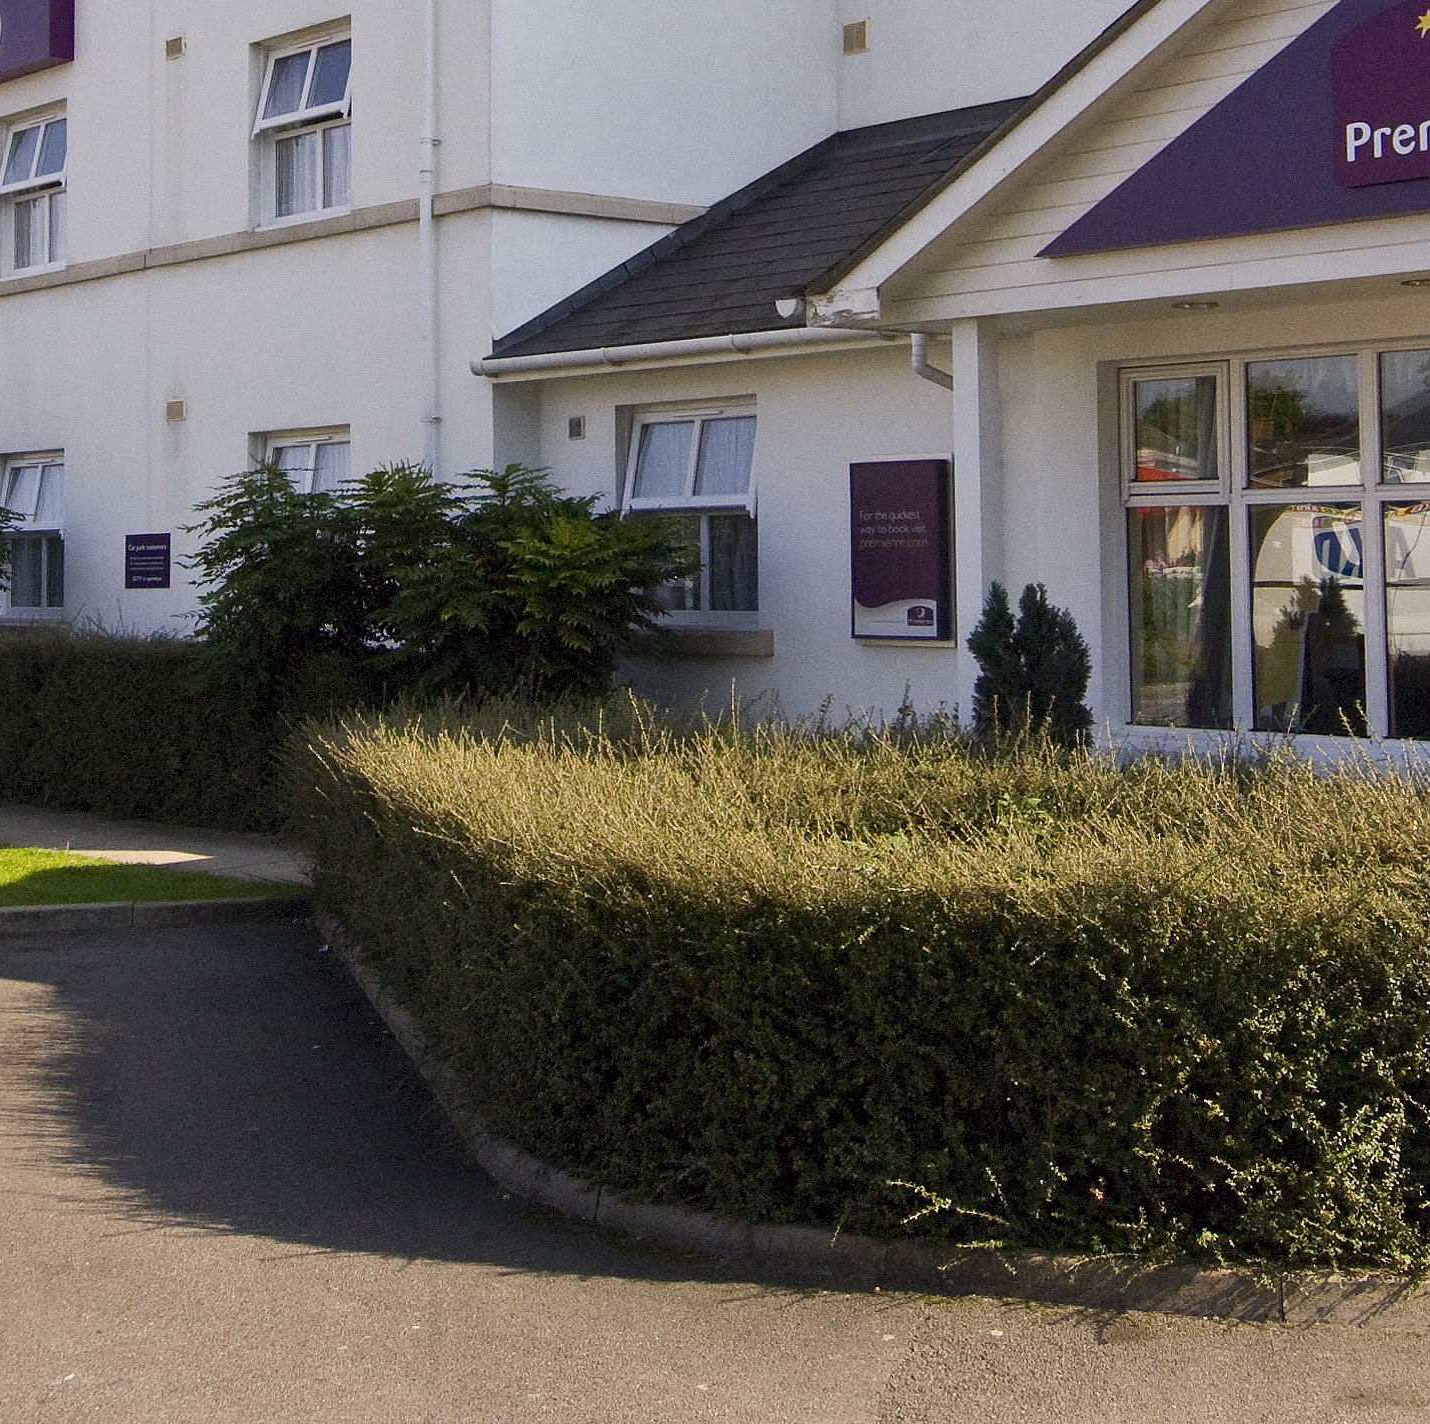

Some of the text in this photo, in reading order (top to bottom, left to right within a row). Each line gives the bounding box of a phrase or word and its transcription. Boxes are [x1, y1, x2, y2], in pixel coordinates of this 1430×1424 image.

[859, 510, 872, 521] For
[877, 525, 887, 535] to
[888, 524, 909, 535] book
